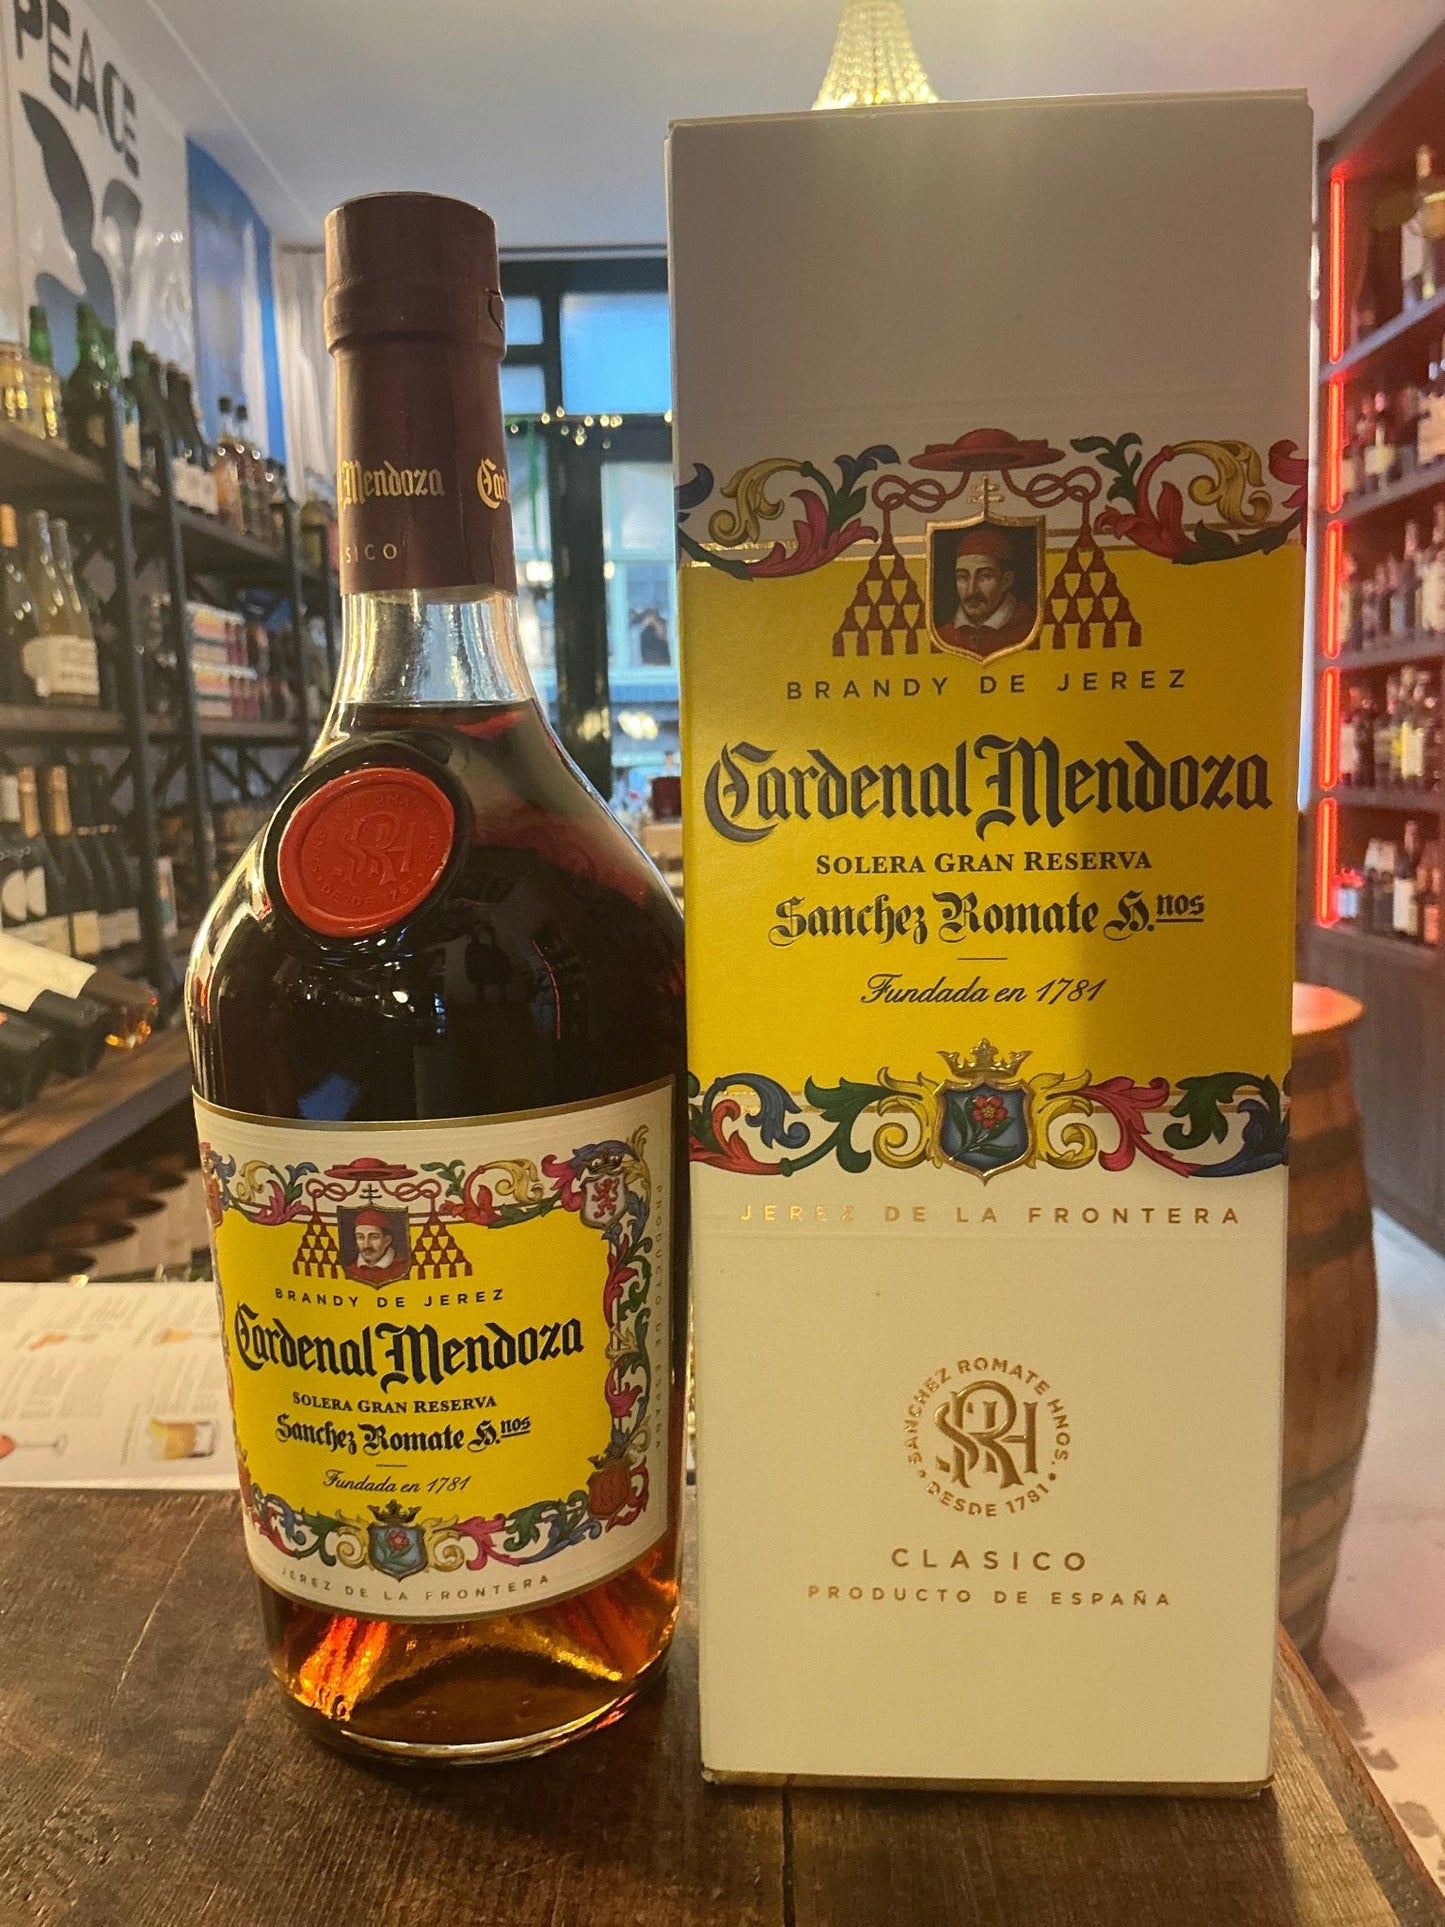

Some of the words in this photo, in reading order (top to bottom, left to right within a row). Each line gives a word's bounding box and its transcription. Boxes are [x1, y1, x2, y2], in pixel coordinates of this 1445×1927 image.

[13, 0, 141, 180] PEACE
[341, 460, 446, 510] Mendoza
[785, 677, 950, 700] BRANDY
[979, 673, 1026, 694] DE
[1056, 669, 1186, 692] JEREZ
[703, 739, 973, 844] Cardenal
[973, 733, 1274, 842] Mendoza
[816, 854, 926, 875] SOLERA
[934, 852, 1015, 874] GRAN
[1023, 850, 1153, 872] RESERVA
[767, 892, 929, 947] Sanchez
[931, 890, 1100, 942] Romate
[859, 973, 989, 1005] Fundada
[993, 986, 1027, 1004] en
[1035, 978, 1108, 1005] 1781
[740, 1204, 855, 1223] JEREZ
[883, 1205, 928, 1224] DE
[956, 1206, 999, 1225] LA
[1027, 1206, 1240, 1225] FRONTERA
[275, 1287, 359, 1308] BRANDY
[376, 1295, 407, 1309] DE
[424, 1288, 505, 1307] JEREZ
[234, 1301, 377, 1378] Cardenal
[374, 1316, 584, 1394] Mendoza
[292, 1392, 353, 1412] SOLERA
[357, 1399, 407, 1415] GRAN
[414, 1395, 498, 1415] RESERVA
[904, 1367, 951, 1465] SANCHEZ
[957, 1357, 1051, 1396] ROMATE
[275, 1412, 358, 1455] Sanchez
[358, 1422, 465, 1456] Romate
[322, 1468, 398, 1493] Fundada
[400, 1482, 422, 1493] en
[426, 1475, 472, 1494] 1781
[926, 1480, 998, 1517] DESDE
[1005, 1482, 1049, 1514] 1781
[890, 1547, 1087, 1572] CLASICO
[282, 1566, 332, 1591] JEREZ
[345, 1585, 369, 1598] DE
[384, 1590, 408, 1601] LA
[425, 1574, 549, 1600] FRONTERA
[807, 1584, 972, 1604] PRODUCTO
[994, 1589, 1029, 1605] DE
[1051, 1588, 1171, 1606] ESPAÑA
